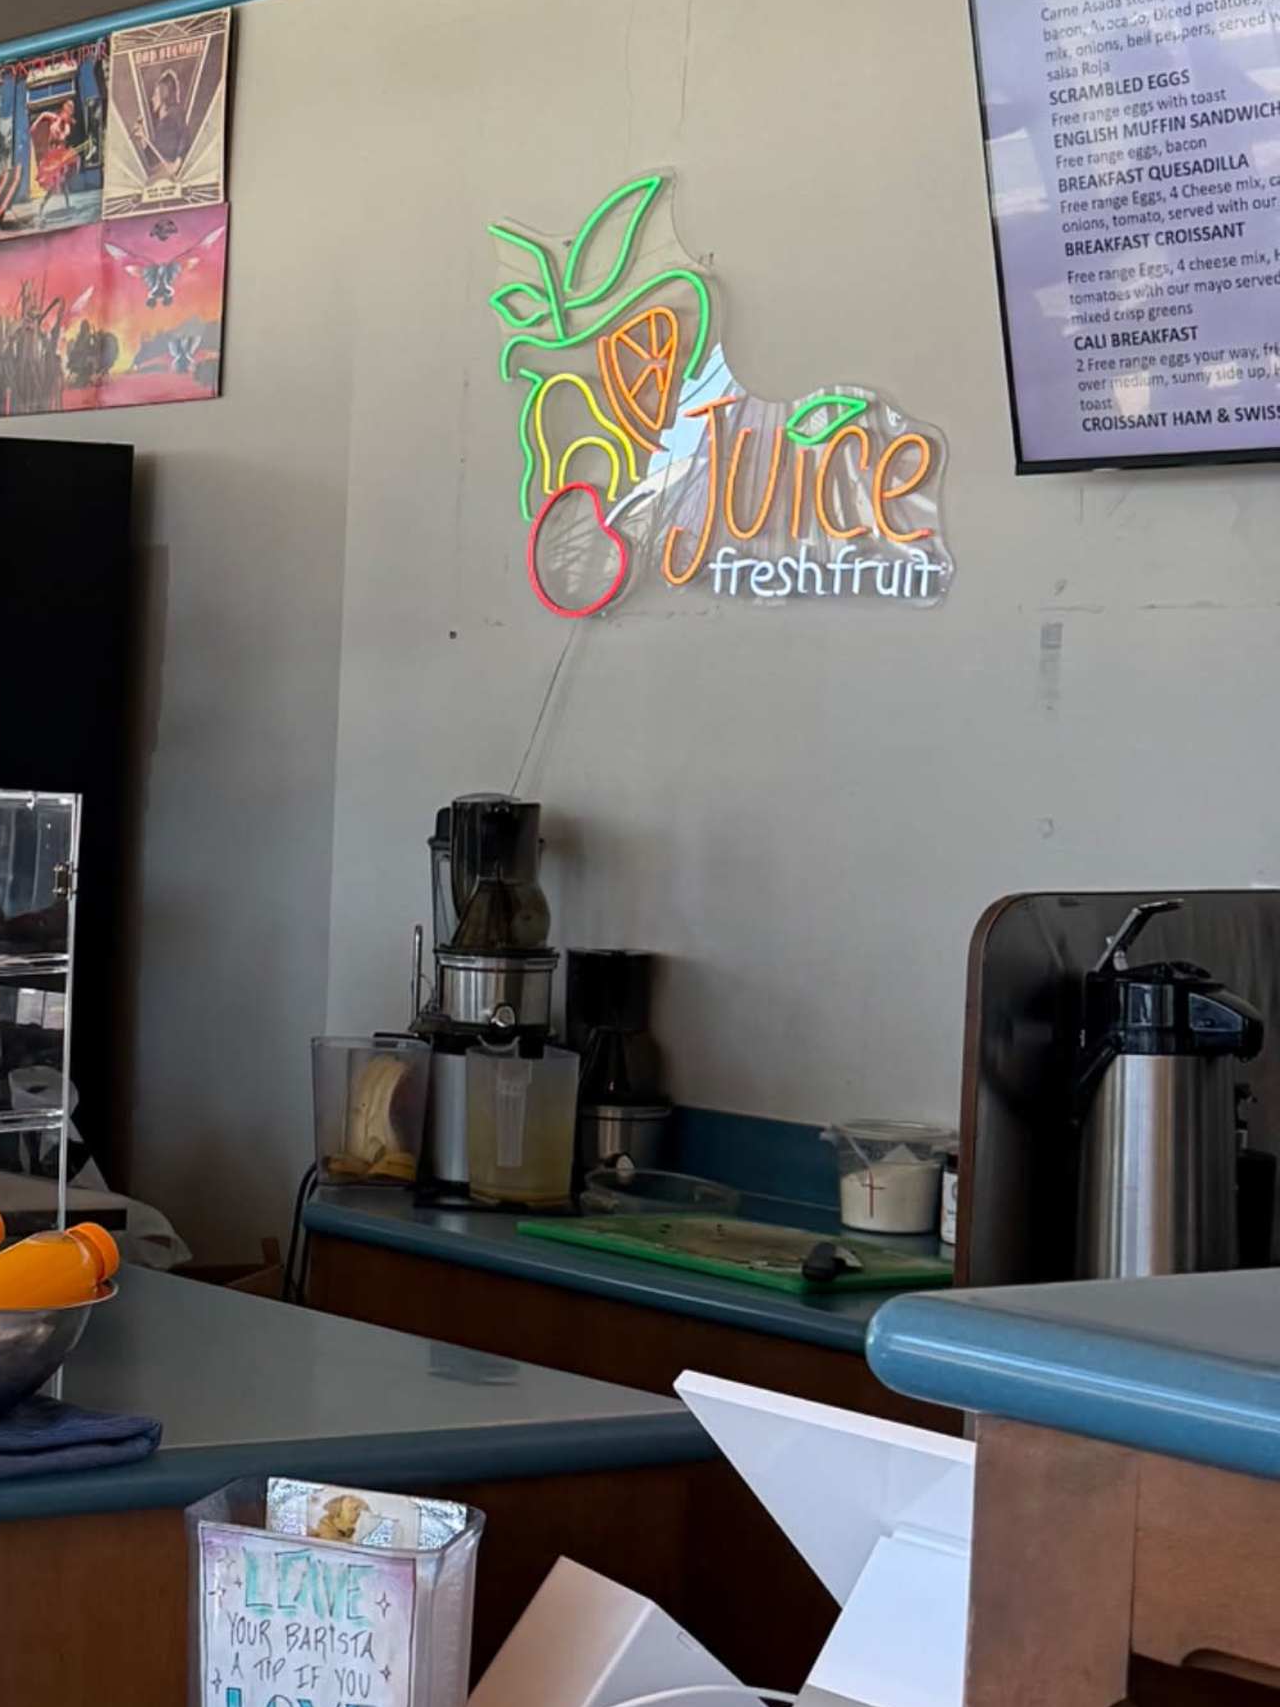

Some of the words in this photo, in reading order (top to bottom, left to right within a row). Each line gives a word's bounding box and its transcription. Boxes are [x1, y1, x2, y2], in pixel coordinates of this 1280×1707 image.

[1041, 6, 1079, 22] Carne
[1076, 37, 1123, 58] onions,
[1082, 58, 1110, 78] Roja
[1049, 77, 1143, 106] SCRAMBLED
[1148, 69, 1190, 90] EGGS
[1051, 112, 1080, 126] Free
[1083, 107, 1120, 122] range
[1123, 101, 1154, 117] eggs
[1157, 94, 1188, 110] with
[1191, 89, 1227, 104] toast
[1053, 126, 1118, 149] ENGLISH
[1123, 116, 1186, 139] MUFFIN
[1190, 100, 1280, 129] SANDWICH
[1056, 154, 1084, 169] Free
[1087, 148, 1124, 165] range
[1128, 144, 1162, 161] eggs,
[1166, 138, 1207, 154] bacon
[1058, 167, 1144, 193] BREAKFAST
[1148, 154, 1249, 181] QUESADILLA
[1060, 200, 1088, 214] Free
[1092, 194, 1128, 210] range
[1132, 190, 1166, 207] Eggs,
[1170, 186, 1178, 199] 4
[1181, 180, 1232, 199] Cheese
[1236, 176, 1265, 190] mix,
[1062, 218, 1109, 234] onions,
[1112, 210, 1165, 228] tomato,
[1168, 203, 1214, 219] served
[1217, 198, 1248, 214] with
[1253, 195, 1277, 209] our
[1065, 233, 1150, 257] BREAKFAST
[1155, 222, 1245, 247] CROISSANT
[1068, 269, 1096, 284] Free
[1099, 266, 1136, 282] range
[1177, 259, 1185, 271] 4
[1189, 254, 1237, 270] cheese
[1241, 249, 1271, 264] mix,
[1070, 290, 1131, 305] tomatoes
[1133, 283, 1163, 299] with
[1167, 281, 1190, 294] our
[1194, 277, 1232, 293] mayo
[1072, 309, 1110, 325] mixed
[1114, 307, 1145, 323] crisp
[1149, 303, 1193, 321] greens
[1074, 334, 1107, 351] CALI
[1112, 326, 1198, 347] BREAKFAST
[1077, 359, 1084, 372] 2
[1088, 356, 1115, 370] Free
[1120, 352, 1155, 367] range
[1160, 349, 1191, 367] eggs
[1194, 346, 1225, 363] your
[1228, 345, 1259, 359] way,
[1078, 377, 1106, 391] over
[1172, 369, 1212, 385] sunny
[1248, 366, 1270, 380] up,
[1080, 397, 1112, 412] toast
[1083, 410, 1168, 432] CROISSANT
[1173, 406, 1212, 426] HAM
[1217, 408, 1230, 423] &
[1235, 403, 1280, 422] SWISS
[661, 396, 933, 585] Juice
[709, 546, 824, 595] fresh
[830, 545, 940, 597] fruit
[244, 1548, 377, 1625] LEAVE
[226, 1613, 271, 1650] YOUR
[286, 1622, 375, 1663] BARISTA
[231, 1653, 243, 1679] A
[254, 1658, 286, 1683] TIP
[296, 1665, 321, 1689] IF
[335, 1669, 371, 1699] YOU
